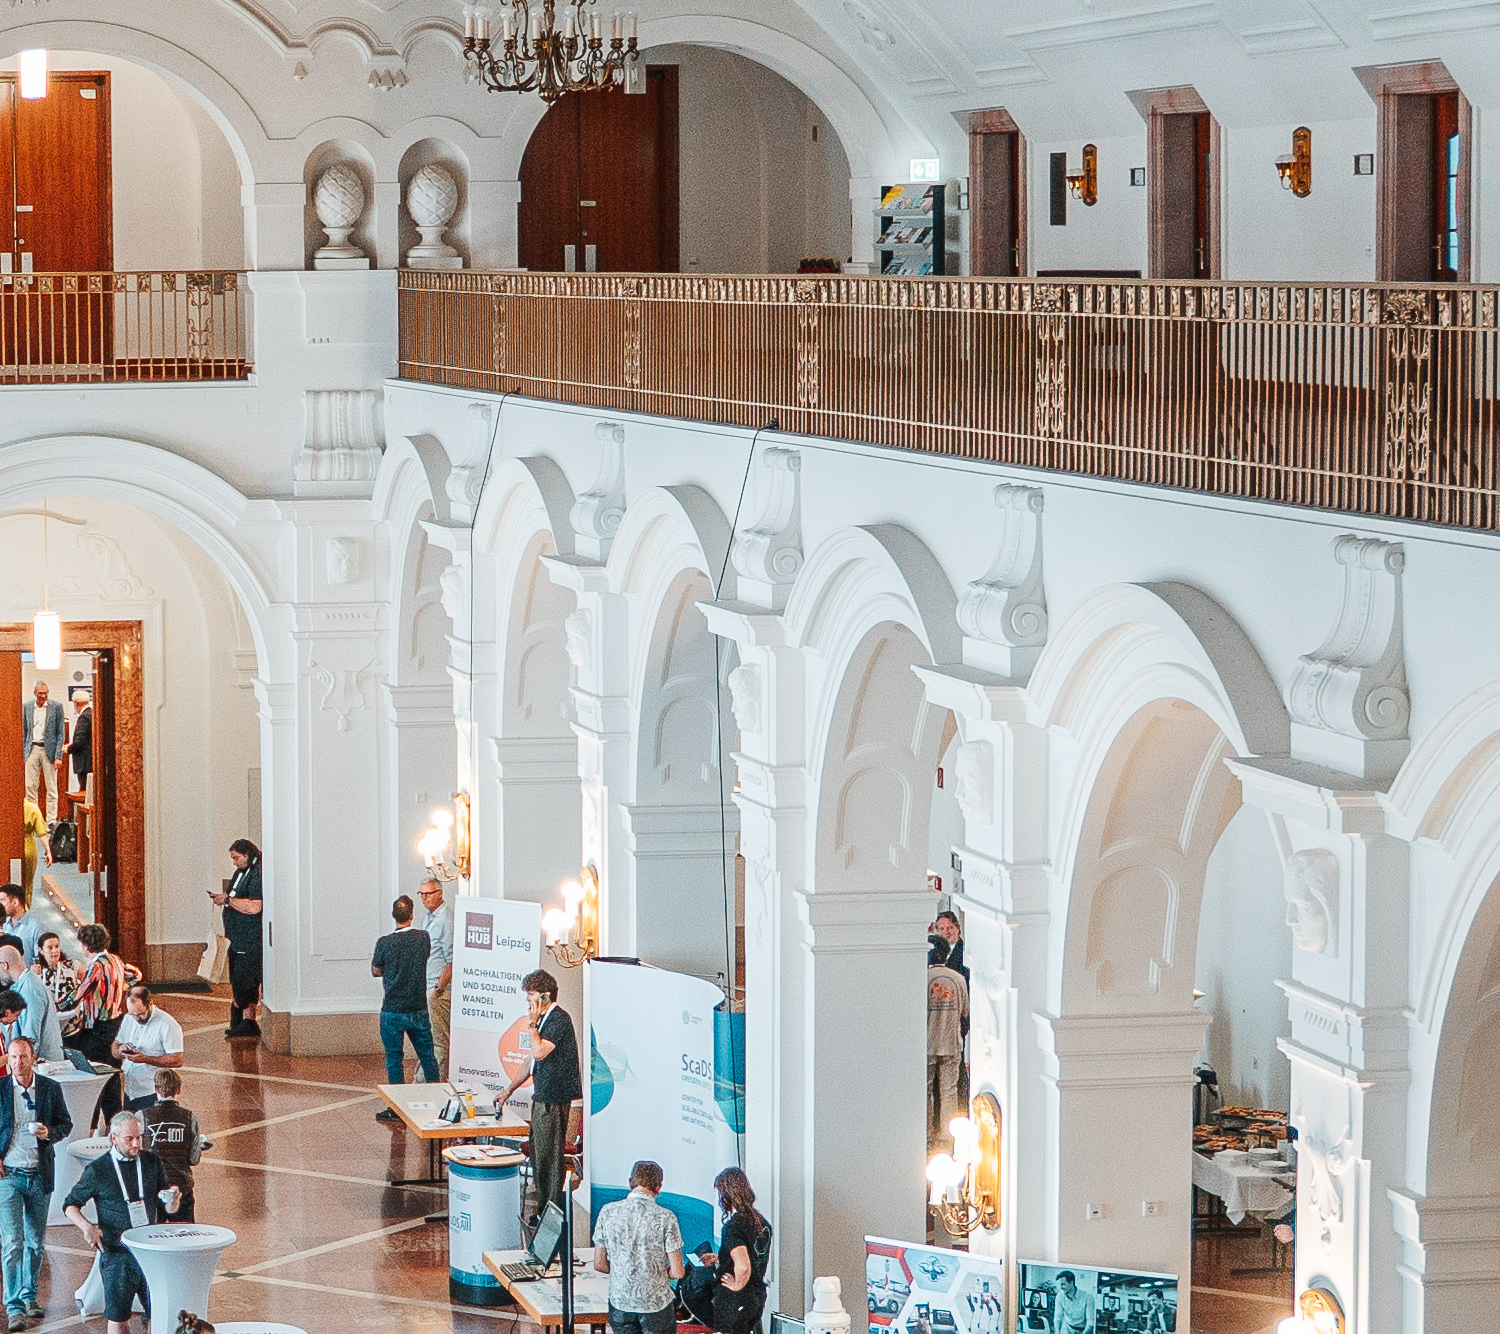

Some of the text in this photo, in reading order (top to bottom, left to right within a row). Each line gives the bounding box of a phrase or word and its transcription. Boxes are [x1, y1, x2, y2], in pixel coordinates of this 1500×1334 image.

[468, 931, 490, 945] HUB
[496, 935, 531, 951] Leipzig
[464, 967, 522, 981] NACHHALTIGEN
[462, 981, 516, 994] UND SOZIALEN
[462, 995, 494, 1005] WANDEL
[462, 1008, 504, 1019] GESTALTEN
[459, 1066, 500, 1078] Innovation
